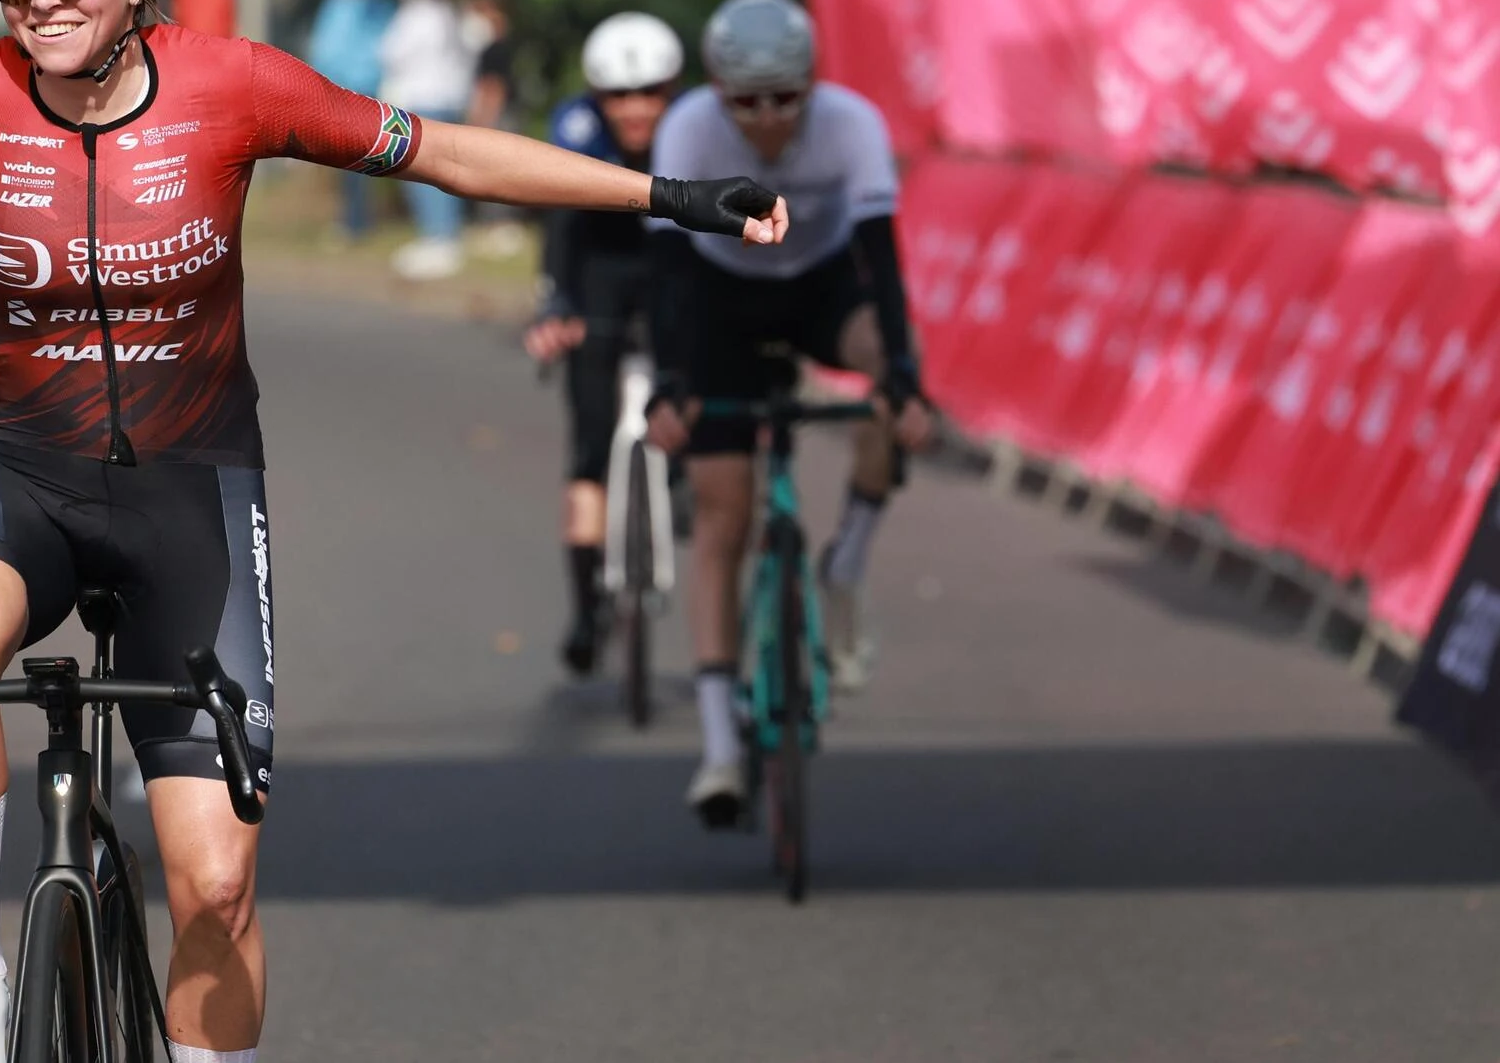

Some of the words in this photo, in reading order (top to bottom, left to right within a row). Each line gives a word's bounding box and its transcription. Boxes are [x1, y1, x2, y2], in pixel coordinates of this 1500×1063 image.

[142, 127, 159, 135] UCI
[160, 120, 200, 131] WOMEN'S
[143, 126, 199, 141] CONTINENTAL
[144, 138, 165, 148] TEAM
[3, 161, 56, 175] wahoo
[11, 176, 55, 186] MADISON
[133, 170, 179, 185] SCHWALBE
[0, 191, 53, 207] LAZER
[135, 179, 187, 204] 4iiii
[67, 217, 213, 262] Smurfit
[66, 235, 229, 286] Westrock
[50, 299, 197, 322] RIBBLE
[31, 342, 184, 362] MAVIC
